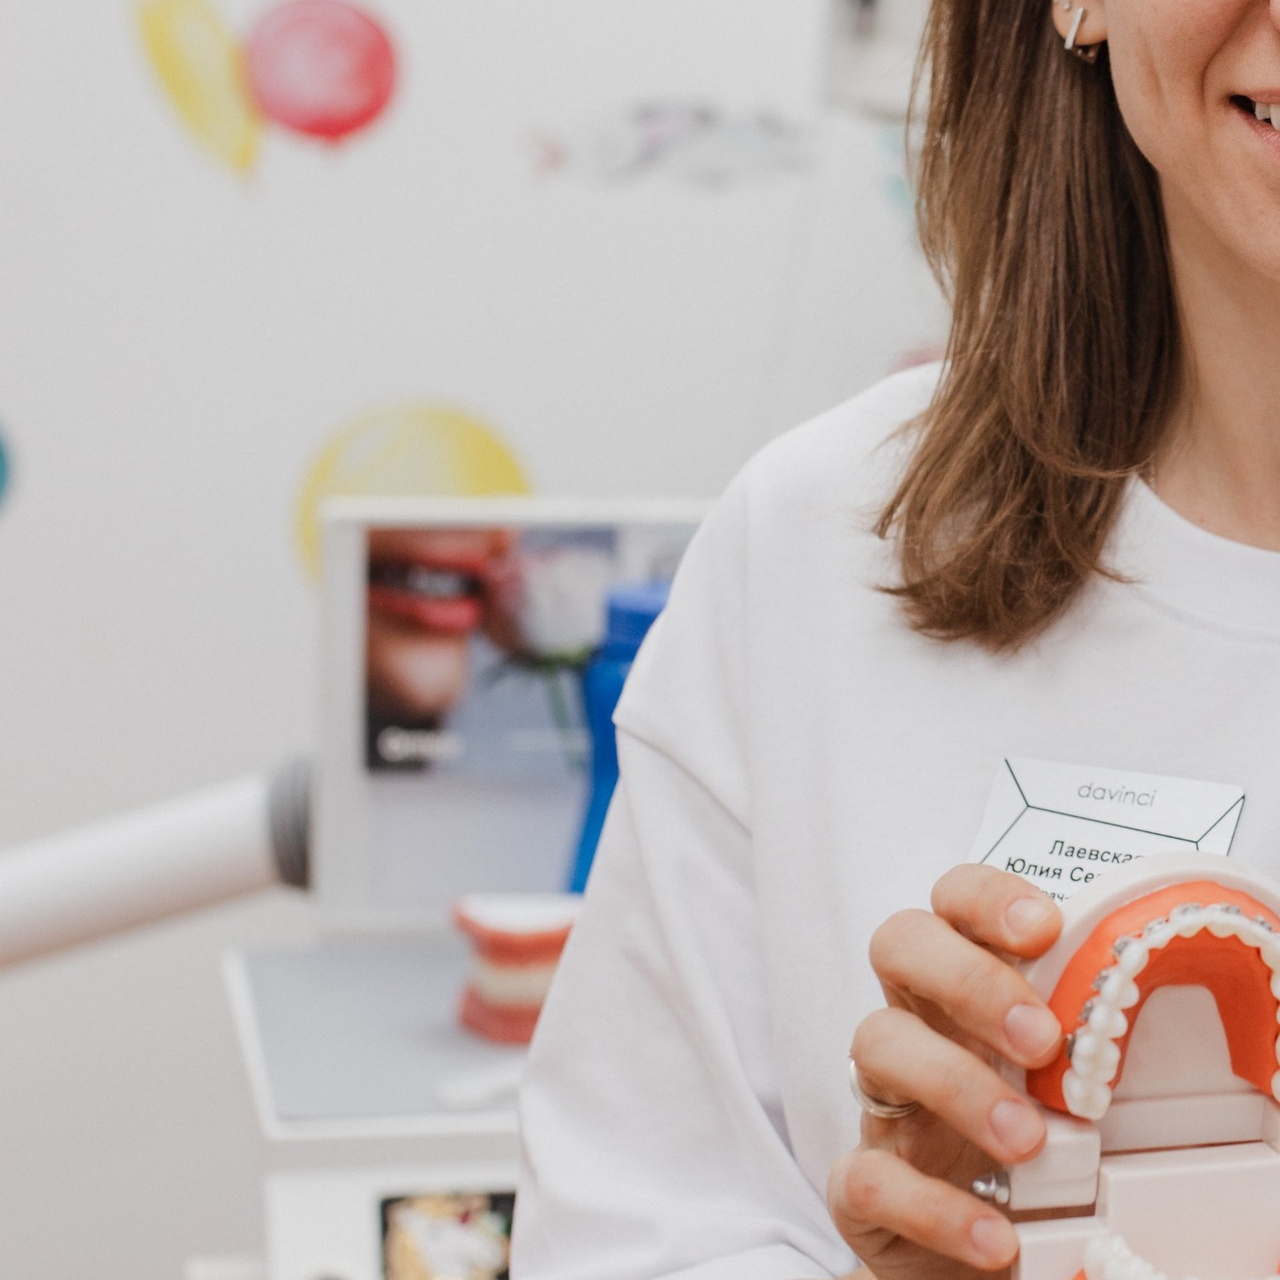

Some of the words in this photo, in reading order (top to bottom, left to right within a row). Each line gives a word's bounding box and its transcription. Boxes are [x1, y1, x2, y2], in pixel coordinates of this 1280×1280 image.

[1077, 781, 1157, 808] davinci
[1048, 839, 1146, 864] Лаевска
[1005, 857, 1063, 880] Юлия
[1070, 866, 1103, 884] Се
